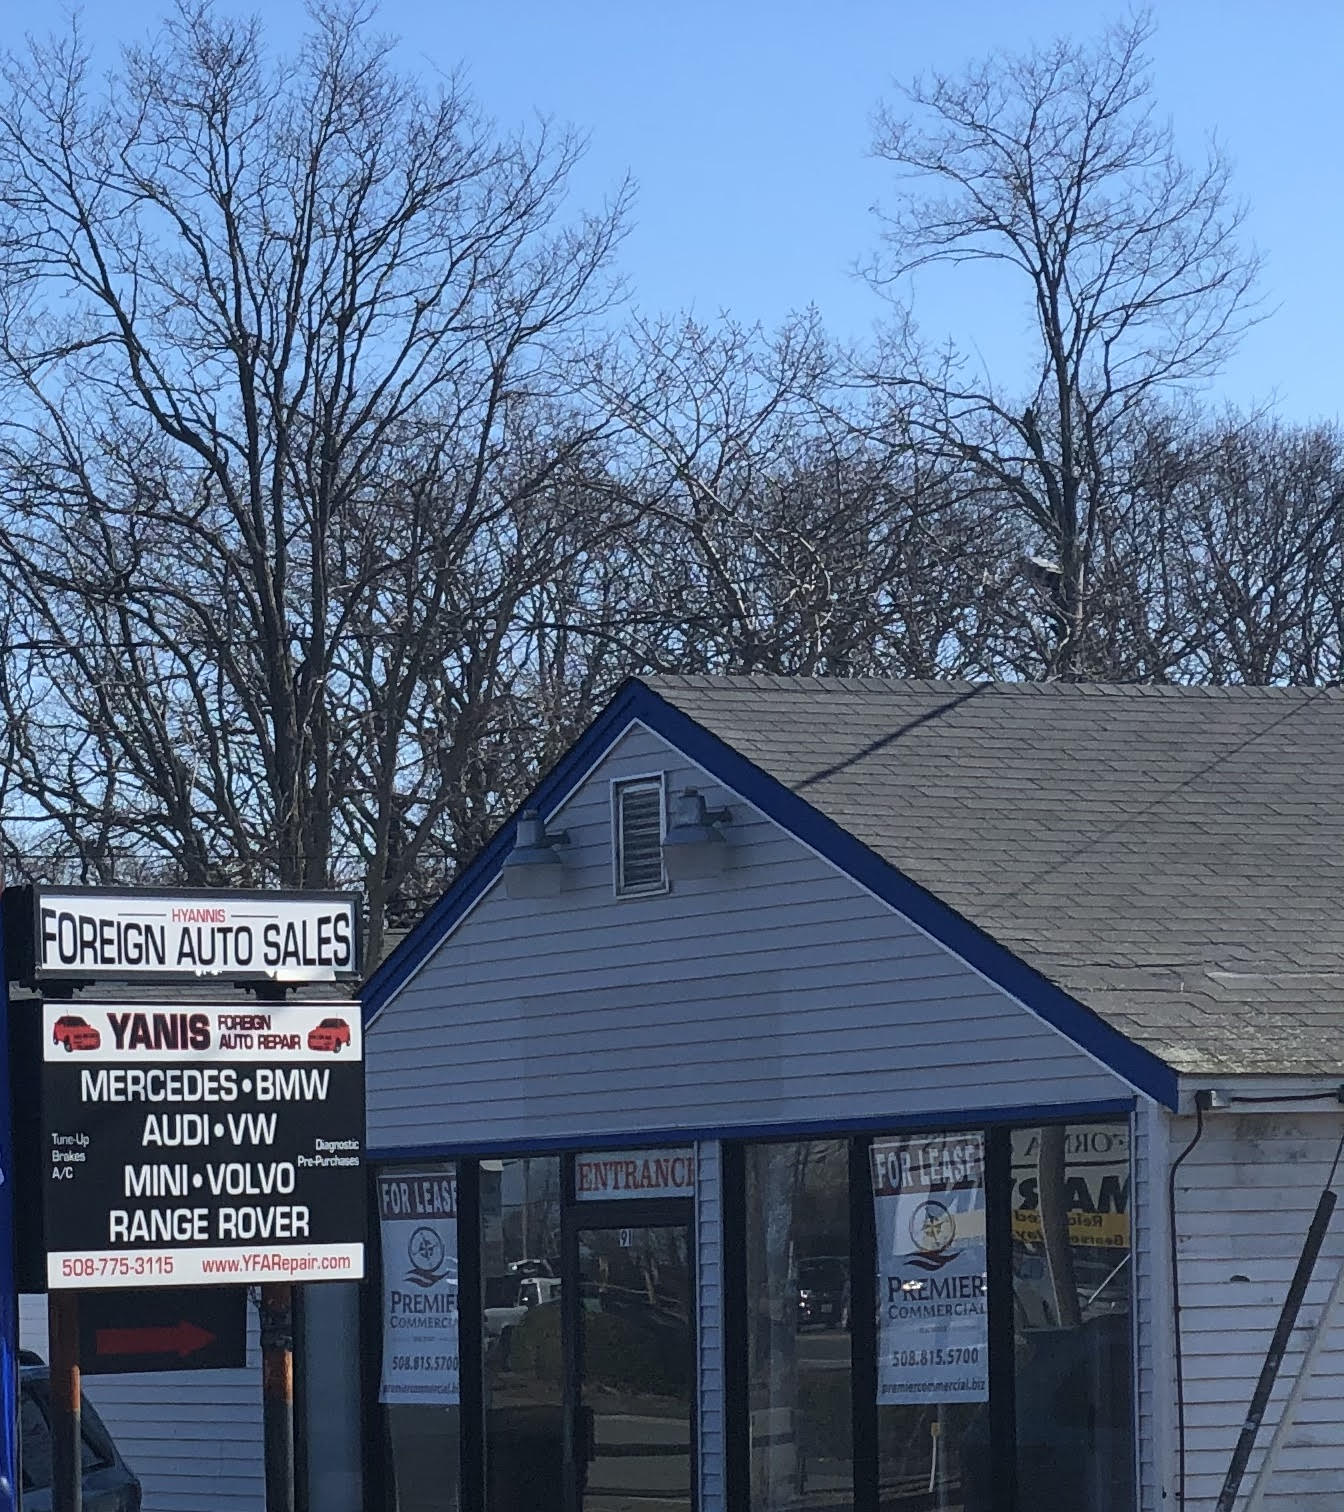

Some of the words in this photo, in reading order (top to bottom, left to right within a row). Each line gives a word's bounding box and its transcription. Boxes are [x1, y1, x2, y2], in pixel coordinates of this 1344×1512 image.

[171, 908, 226, 923] HYANNIS
[41, 908, 165, 966] FOREIGN
[177, 925, 253, 967] AUTO
[263, 912, 350, 967] SALES
[106, 1012, 211, 1051] YANIS
[217, 1014, 272, 1031] FOREIGN
[219, 1034, 254, 1051] AUTO
[258, 1034, 301, 1051] REPAIR
[51, 1133, 90, 1147] Tune-Up
[315, 1138, 360, 1152] Diagnostic
[52, 1150, 86, 1162] Brakes
[52, 1167, 74, 1180] A/C
[876, 1152, 911, 1189] FOR
[919, 1144, 977, 1186] LEASE
[381, 1182, 411, 1215] FOR
[109, 1209, 209, 1242] RANGE
[218, 1206, 309, 1239] ROVER
[61, 1256, 174, 1278] 508-775-3115
[202, 1252, 351, 1274] www.YFARepair.com
[390, 1291, 455, 1314] PREMIE
[888, 1303, 986, 1320] COMMERCIAL
[892, 1348, 979, 1367] 508.815.5700
